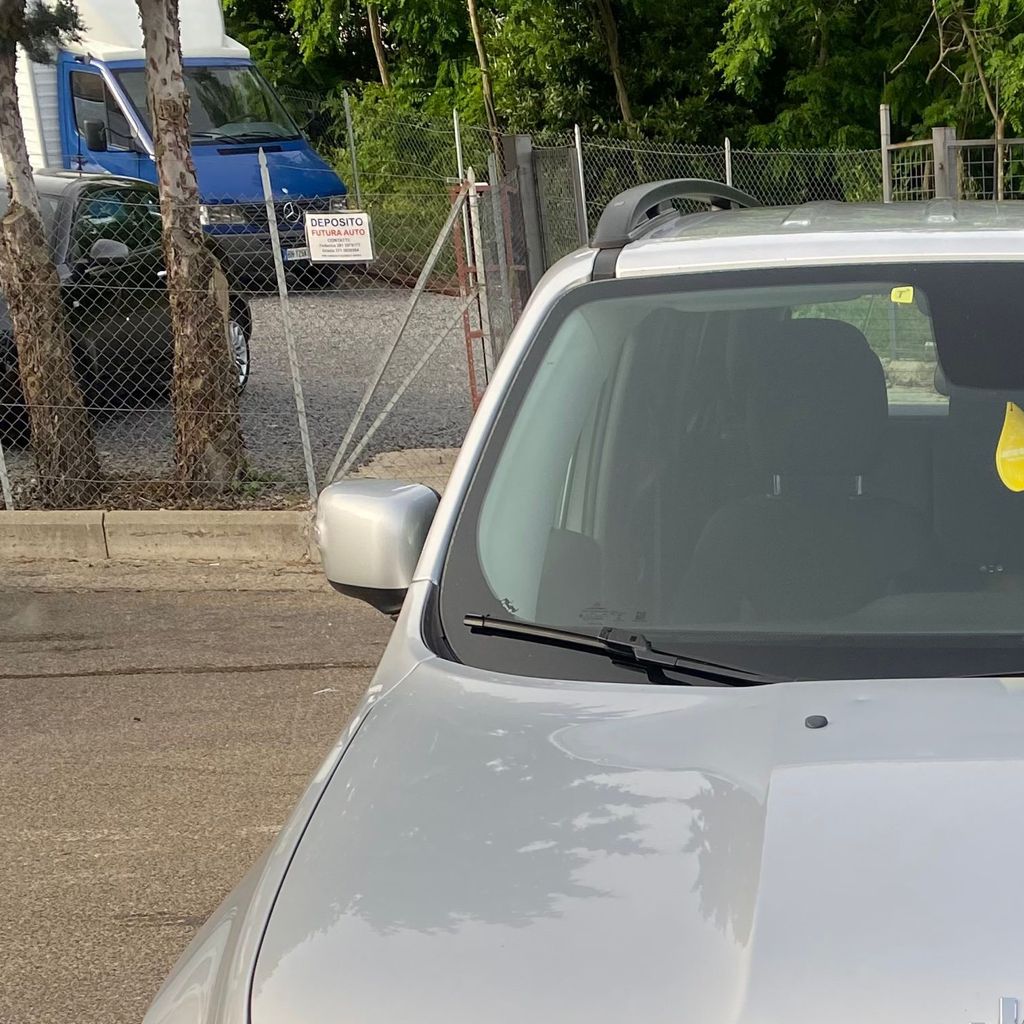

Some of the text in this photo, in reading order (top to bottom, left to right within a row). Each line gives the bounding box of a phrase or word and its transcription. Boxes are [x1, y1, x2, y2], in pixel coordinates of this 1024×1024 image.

[310, 217, 363, 227] DEPOSITO
[311, 228, 365, 237] FUTURA AUTO
